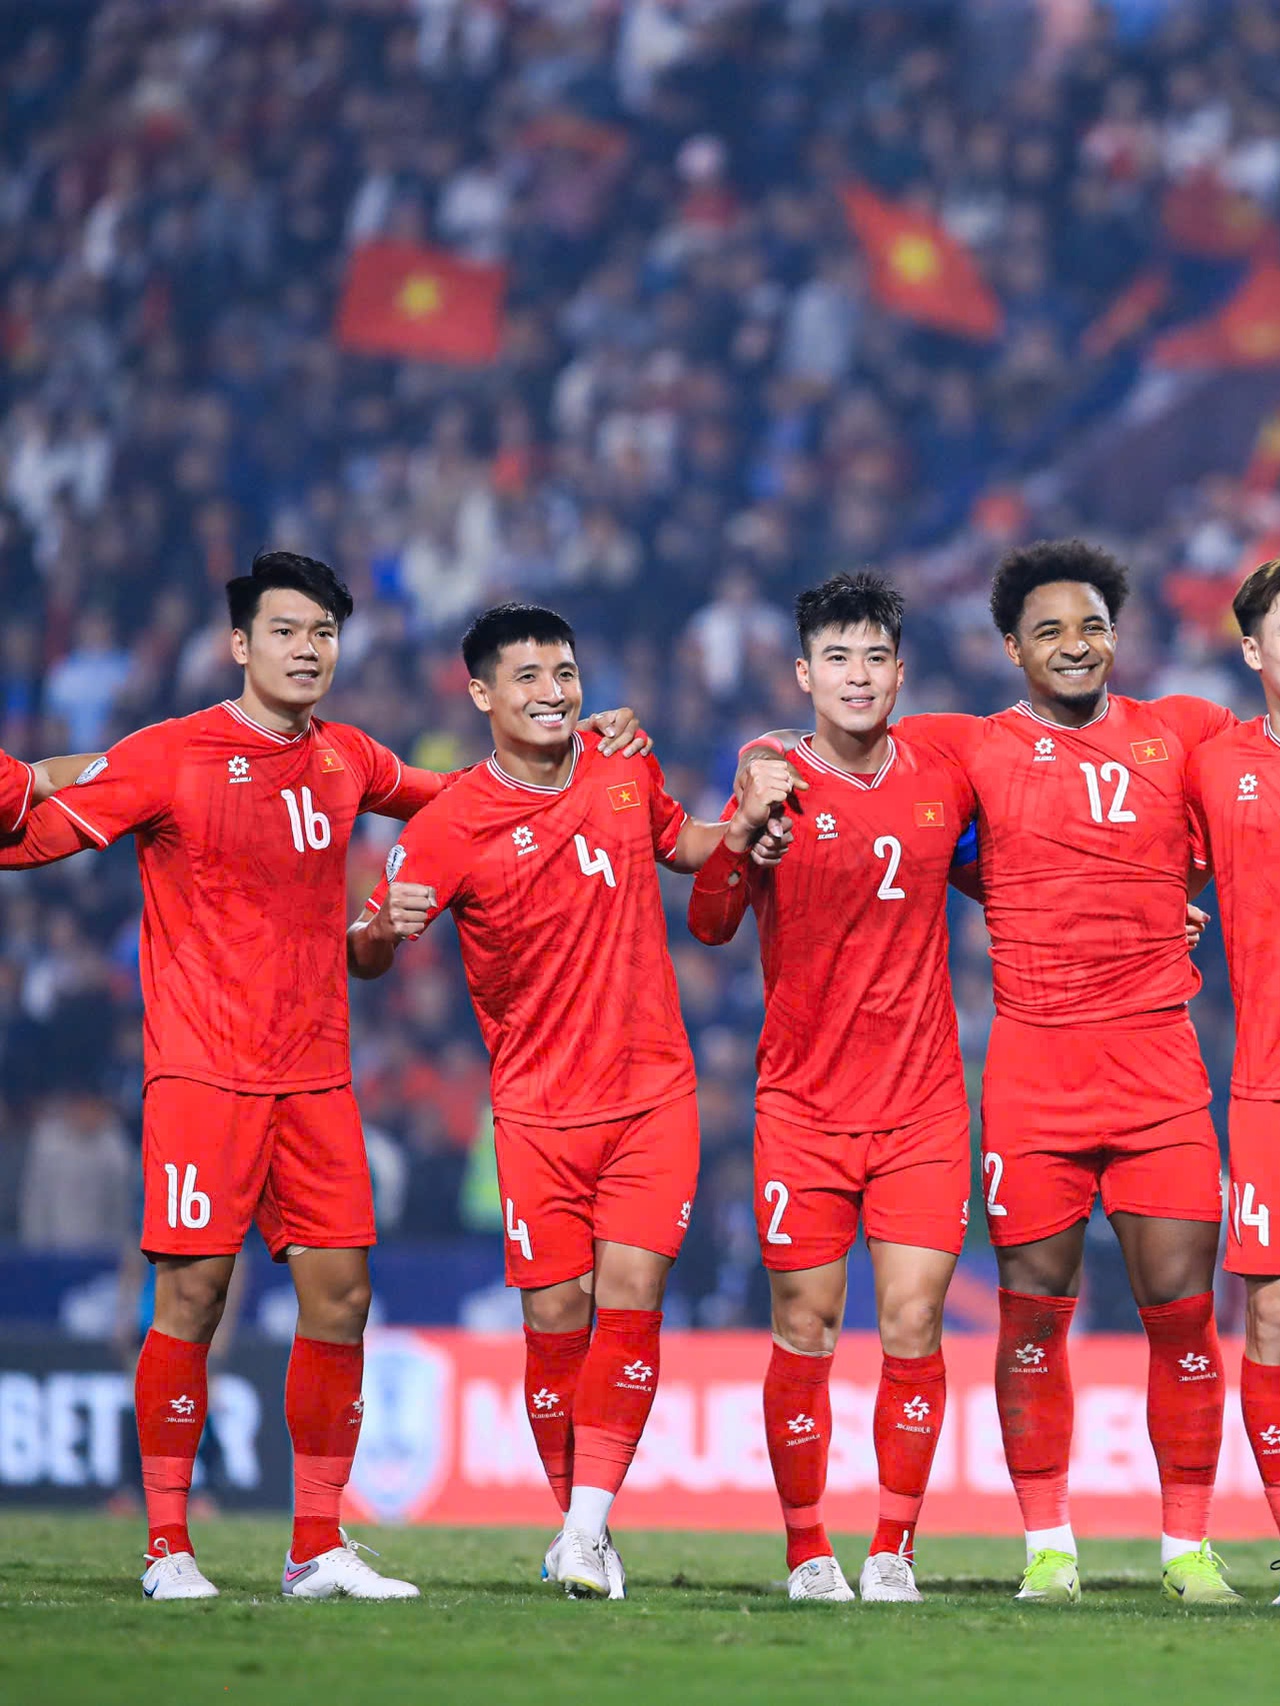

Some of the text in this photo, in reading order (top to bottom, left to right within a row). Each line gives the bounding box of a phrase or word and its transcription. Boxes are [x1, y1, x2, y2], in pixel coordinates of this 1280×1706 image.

[280, 786, 331, 853] 16
[1079, 761, 1137, 823] 12
[573, 834, 617, 888] 4
[873, 835, 906, 900] 2
[164, 1163, 211, 1230] 16
[764, 1180, 792, 1244] 2
[981, 1152, 1008, 1216] 2
[506, 1197, 533, 1260] 4
